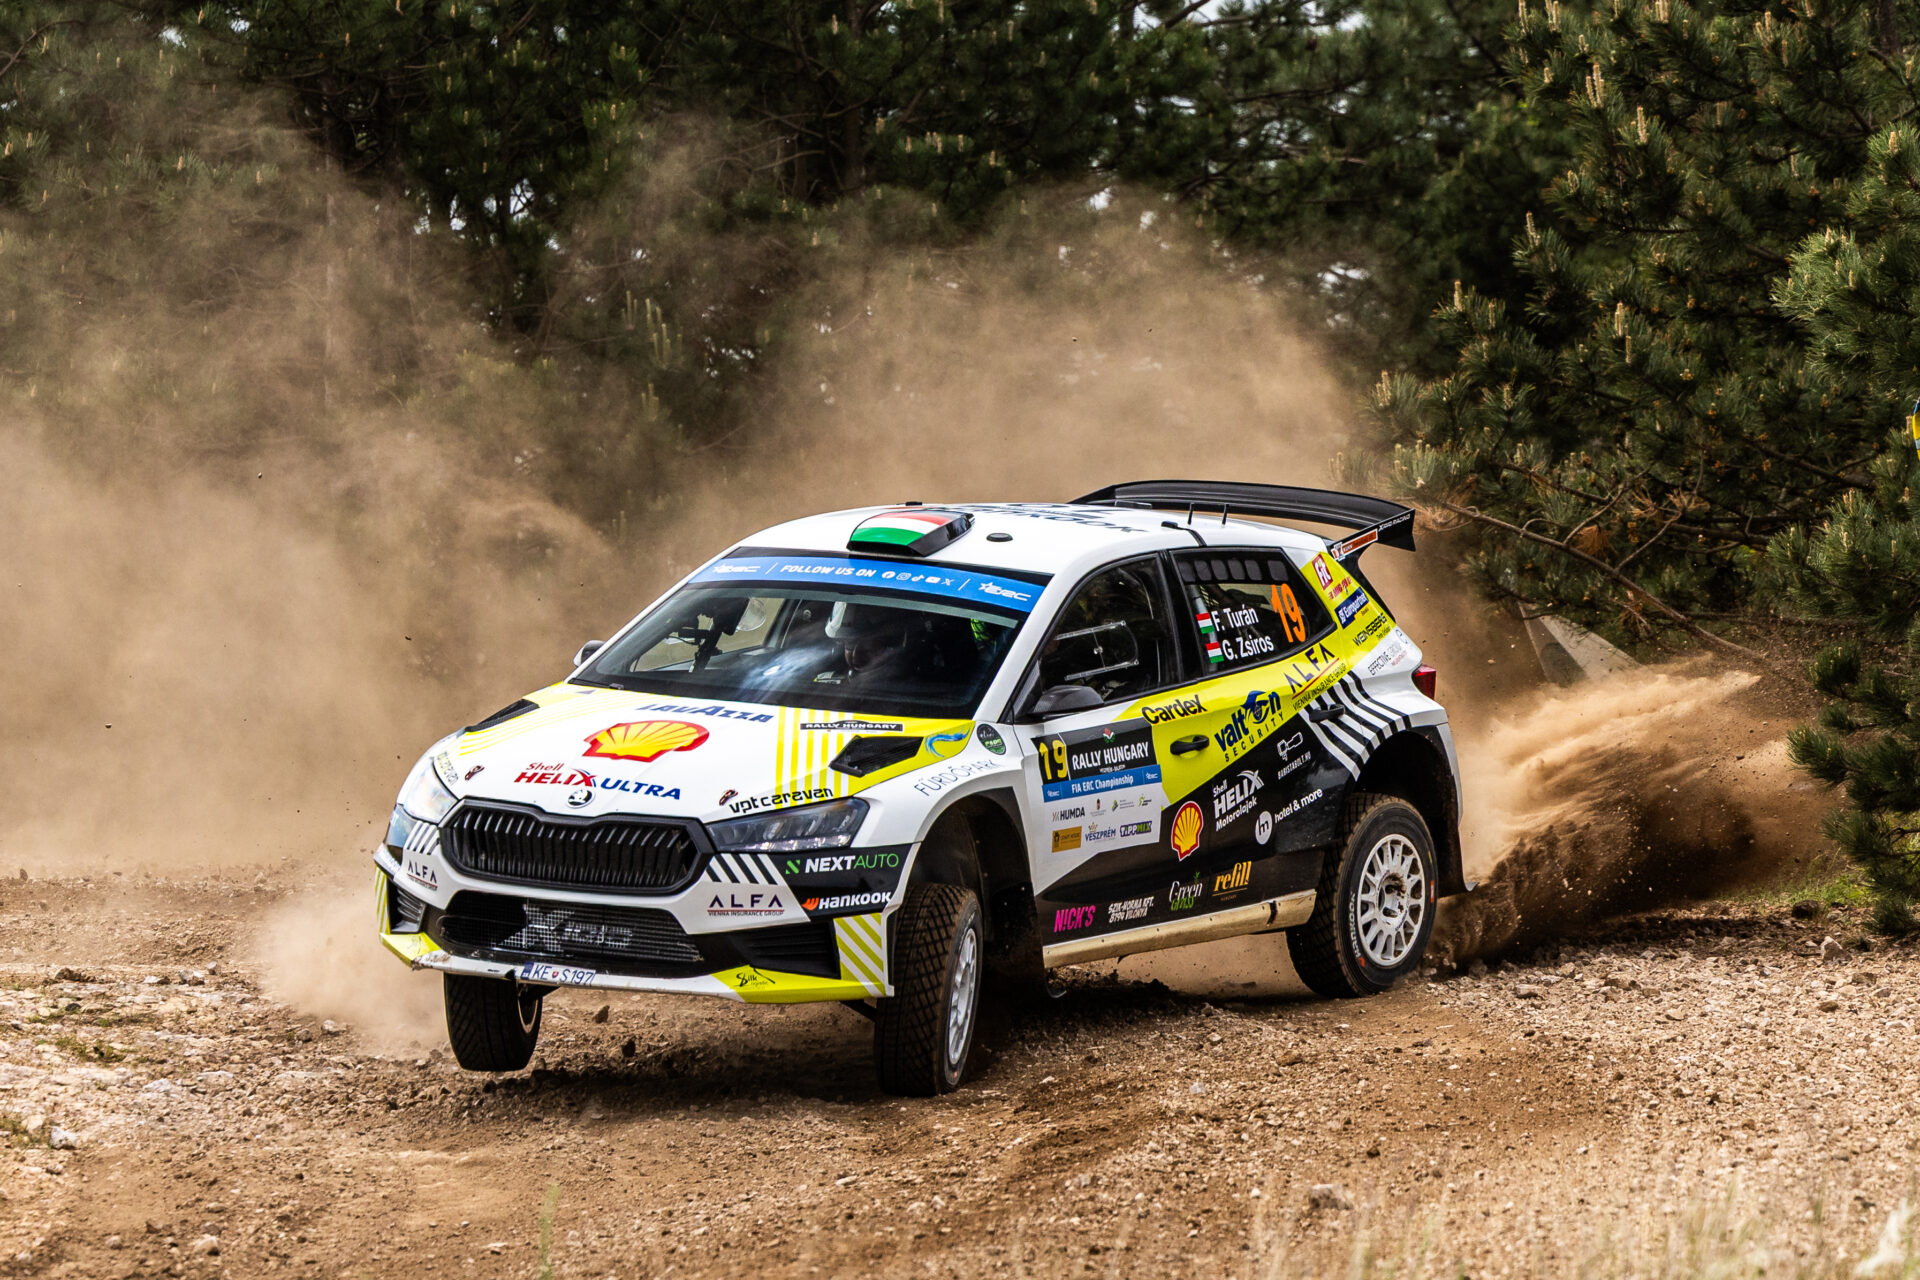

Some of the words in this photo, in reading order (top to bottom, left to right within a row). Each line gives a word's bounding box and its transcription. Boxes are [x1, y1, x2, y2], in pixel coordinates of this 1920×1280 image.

[780, 565, 832, 574] FOLLOW
[835, 567, 855, 575] US
[856, 569, 876, 577] ON
[980, 583, 1032, 602] ERC
[1211, 611, 1225, 631] F.
[1223, 604, 1259, 628] Turán
[1271, 583, 1306, 643] 19
[1353, 612, 1387, 646] WEINSBERG
[1222, 640, 1238, 660] G.
[1236, 635, 1275, 658] Zsiros
[1142, 694, 1207, 724] Cardex
[1225, 713, 1284, 762] SECURITY
[526, 763, 565, 772] Shell
[1039, 740, 1068, 780] 19
[1072, 750, 1101, 770] RALLY
[1103, 741, 1149, 765] HUNGARY
[514, 768, 598, 788] HELIX
[600, 778, 681, 800] ULTRA
[1071, 783, 1082, 794] FIA
[1082, 781, 1095, 792] ERC
[1095, 774, 1134, 789] Championship
[1213, 779, 1228, 797] Shell
[1213, 769, 1264, 819] HELIX
[1060, 807, 1085, 821] HUMDA
[1215, 796, 1258, 832] Motorolajok
[1274, 804, 1294, 824] hotel
[1292, 799, 1301, 812] &
[1300, 788, 1323, 807] more
[1085, 827, 1116, 842] VESZPRÉM
[408, 860, 437, 884] ALFA
[709, 894, 783, 908] ALFA
[1169, 880, 1203, 902] Green
[532, 964, 552, 979] KE
